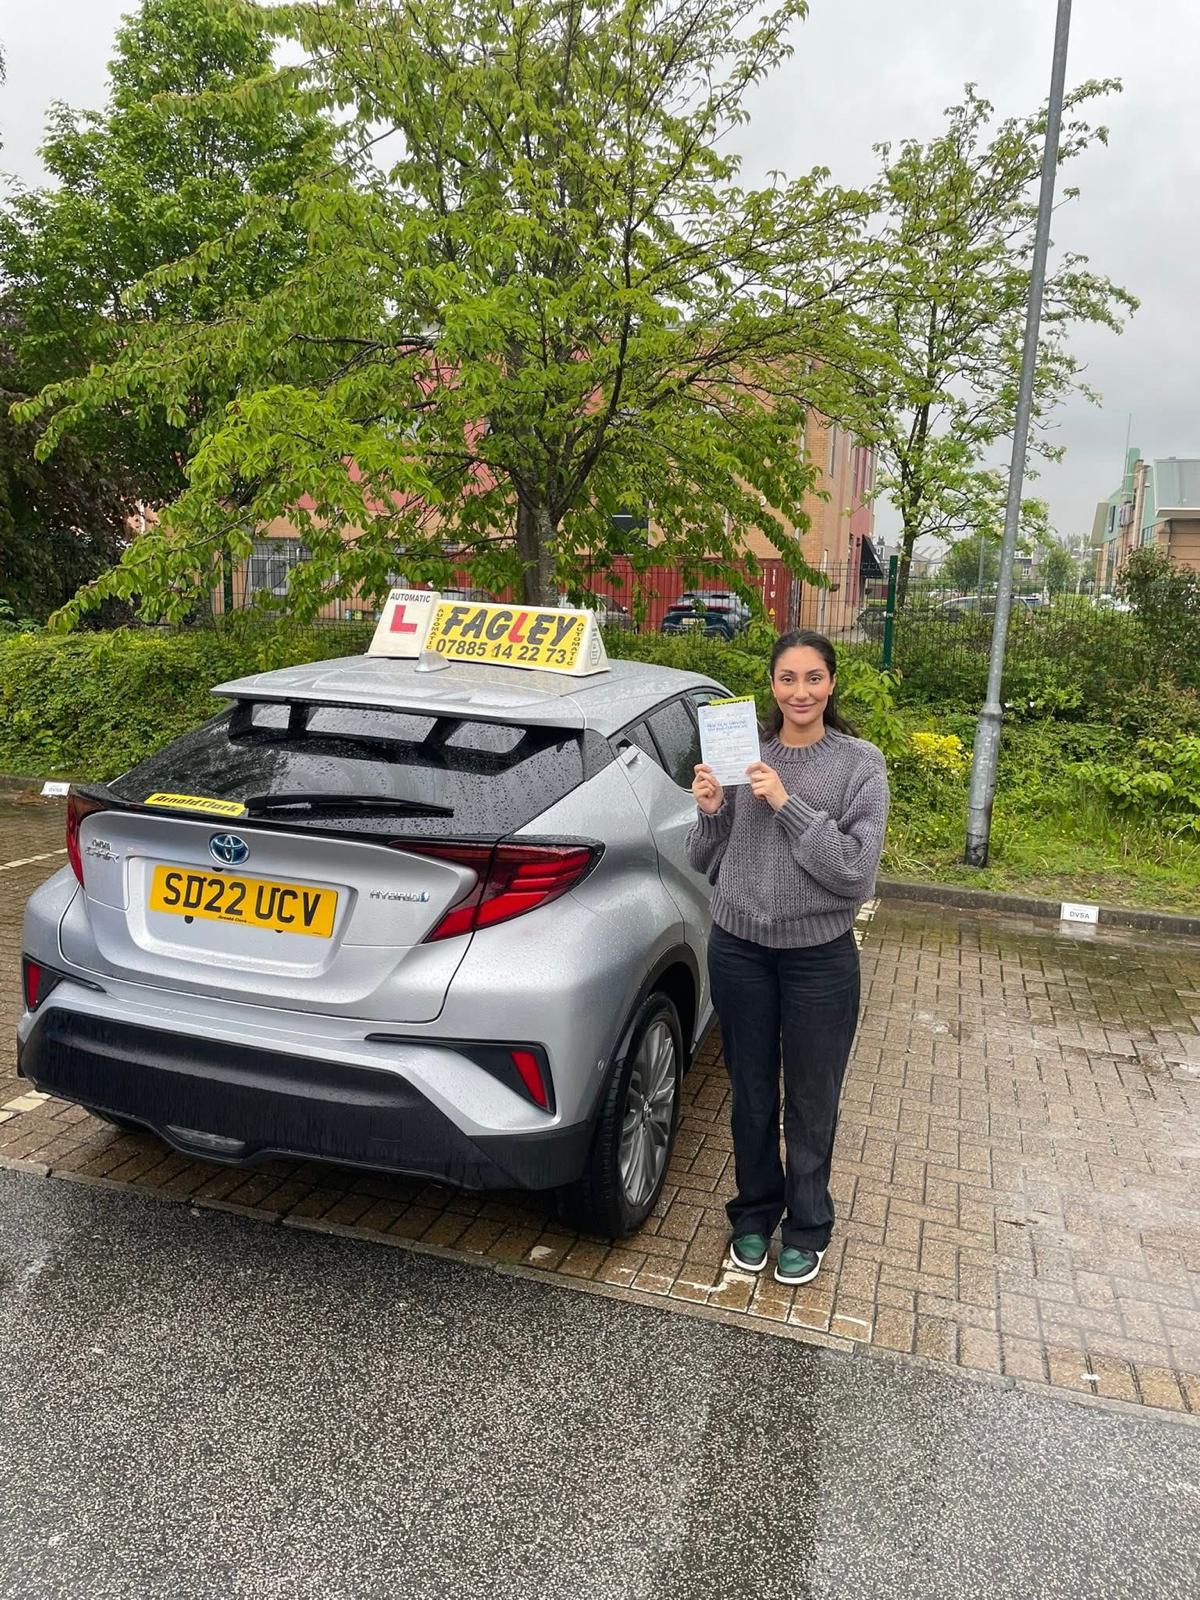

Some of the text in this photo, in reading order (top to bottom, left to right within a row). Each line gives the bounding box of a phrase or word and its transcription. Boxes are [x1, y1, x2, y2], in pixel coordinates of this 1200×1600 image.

[390, 592, 431, 603] AUTOMATIC
[390, 604, 418, 633] L
[426, 607, 445, 650] AUTOMATIC
[441, 606, 578, 647] FAGLEY
[435, 638, 568, 664] 07885 14 22 73
[567, 622, 585, 666] AUTOMATIC
[153, 795, 240, 812] Arnold Clark
[162, 872, 322, 927] SD22 UCV
[369, 889, 420, 902] HYBRID
[1069, 911, 1090, 920] DVSA
